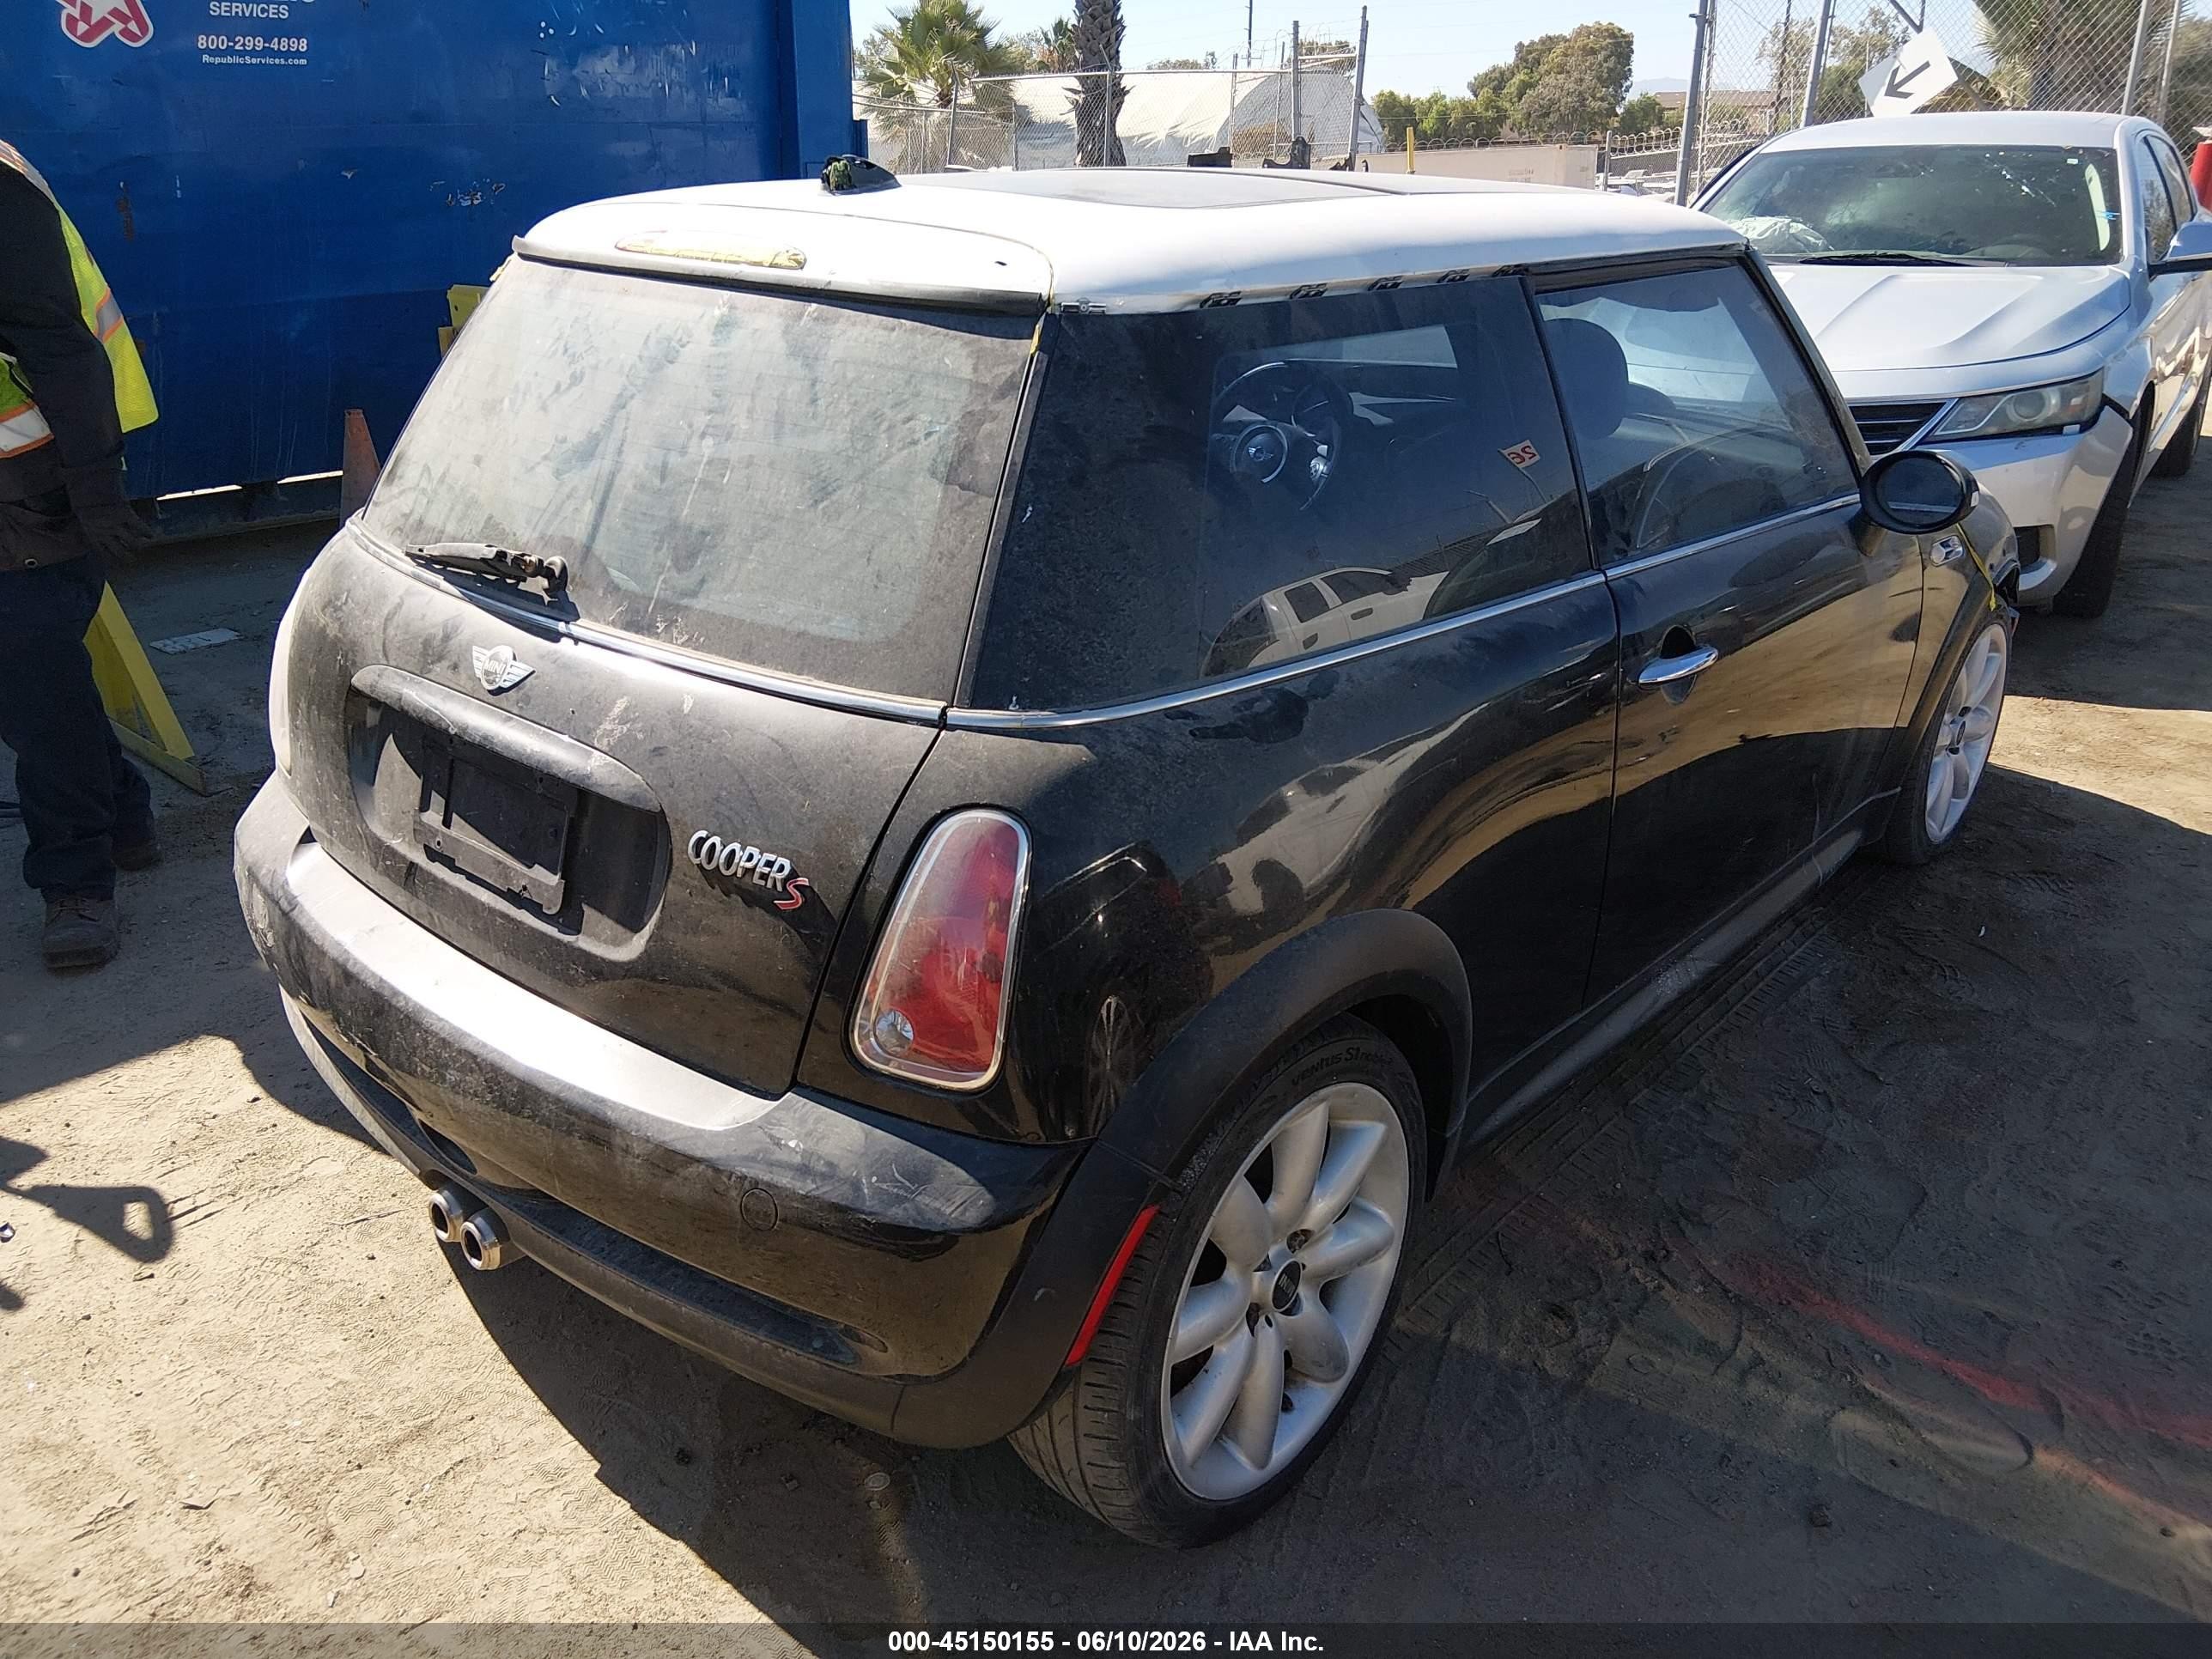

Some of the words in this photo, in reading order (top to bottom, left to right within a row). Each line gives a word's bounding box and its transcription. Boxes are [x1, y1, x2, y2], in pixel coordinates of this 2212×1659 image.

[209, 2, 289, 19] SERVICES
[197, 34, 307, 52] 800-299-4898
[202, 54, 307, 65] RepublicServices.com
[687, 830, 792, 892] COOPER
[773, 877, 810, 910] S
